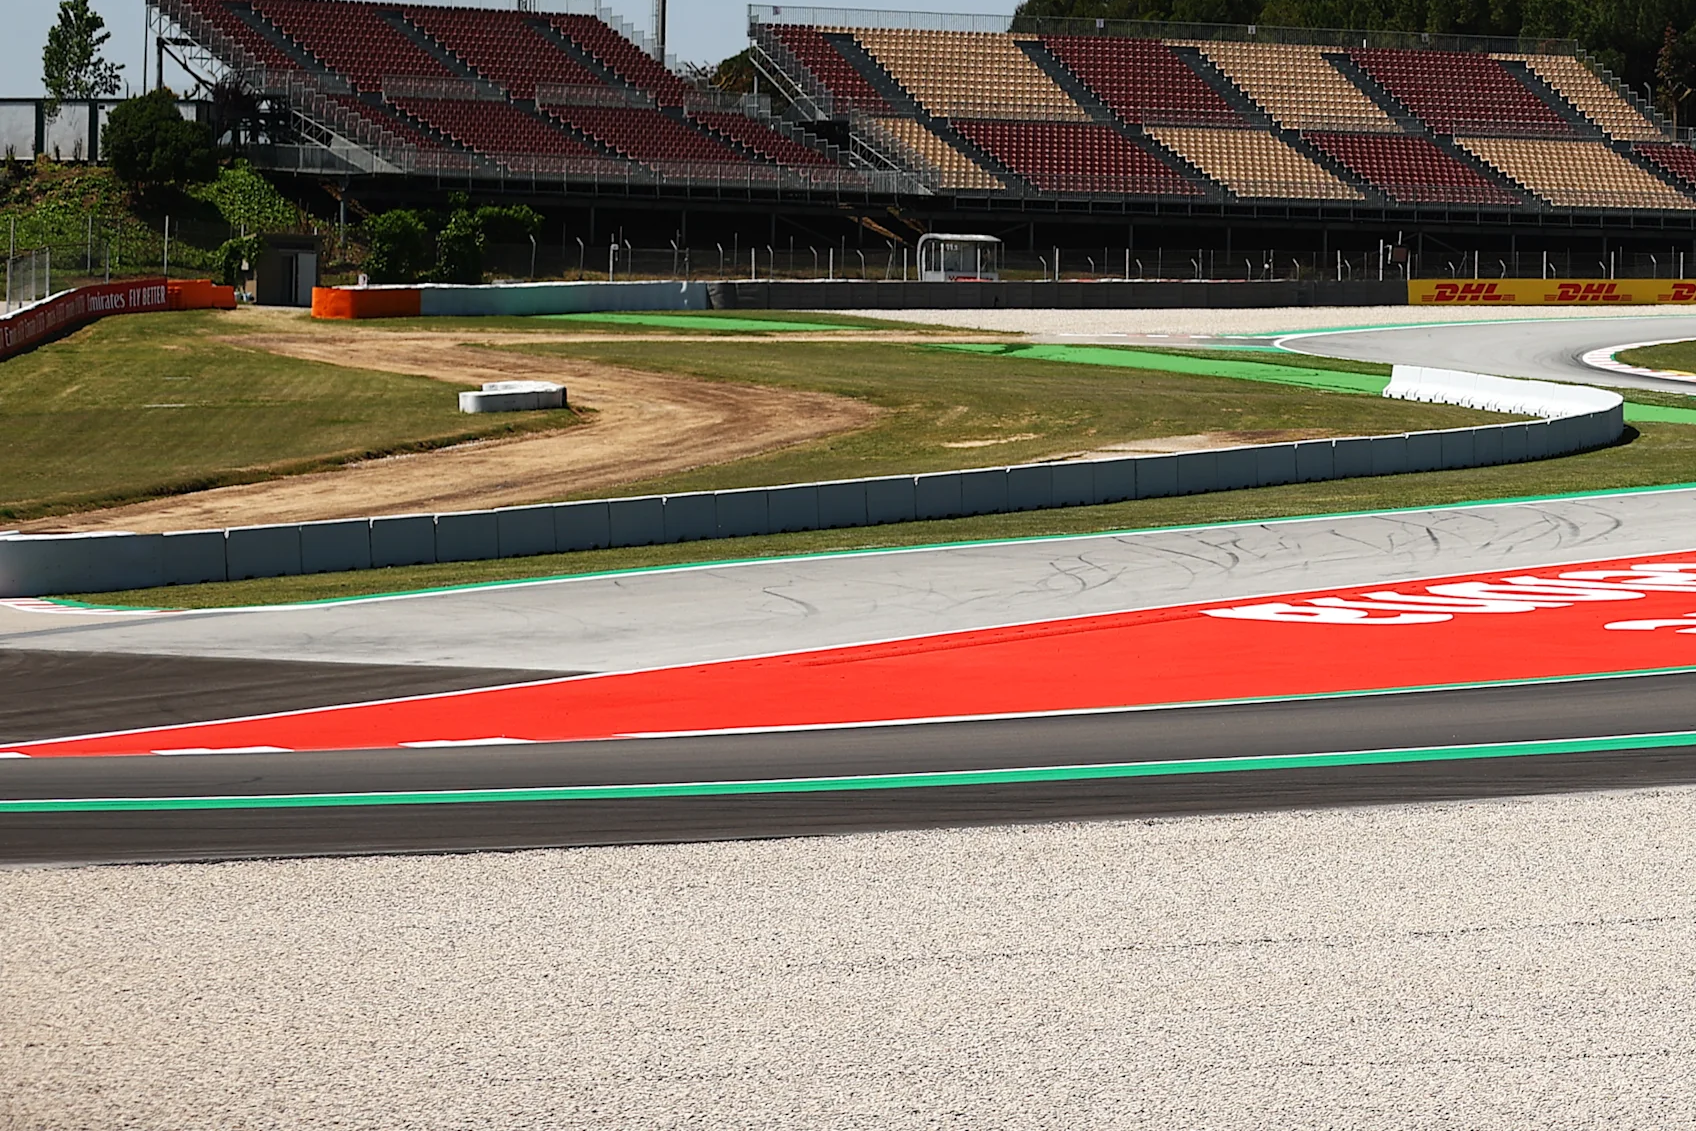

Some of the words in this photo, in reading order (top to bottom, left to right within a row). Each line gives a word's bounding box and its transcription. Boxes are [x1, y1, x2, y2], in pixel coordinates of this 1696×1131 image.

[86, 292, 126, 312] Emirates
[129, 288, 141, 307] FLY
[142, 285, 166, 305] BETTER
[1434, 283, 1504, 301] DHL
[1556, 283, 1620, 301] DHL
